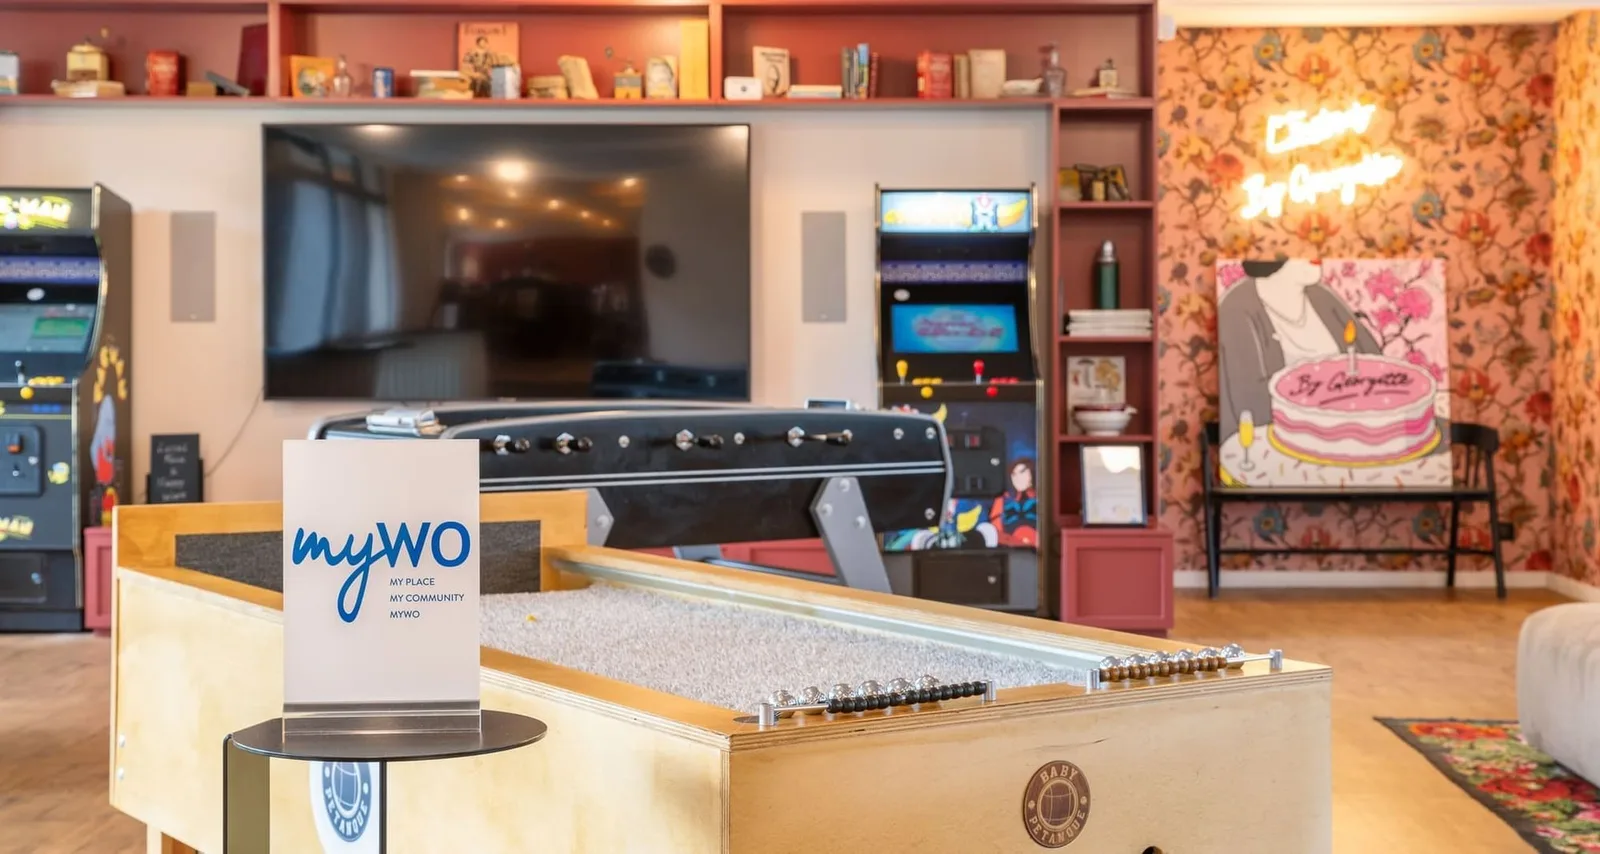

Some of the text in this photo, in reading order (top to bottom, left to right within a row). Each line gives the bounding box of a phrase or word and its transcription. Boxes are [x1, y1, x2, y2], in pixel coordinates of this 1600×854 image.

[1289, 374, 1322, 396] By
[292, 520, 471, 623] myWO
[389, 577, 436, 586] MY PLACE
[389, 593, 465, 603] MY COMMUNITY
[389, 610, 421, 619] MYWO
[1040, 764, 1079, 783] BABY
[1028, 809, 1086, 844] PETANQUE
